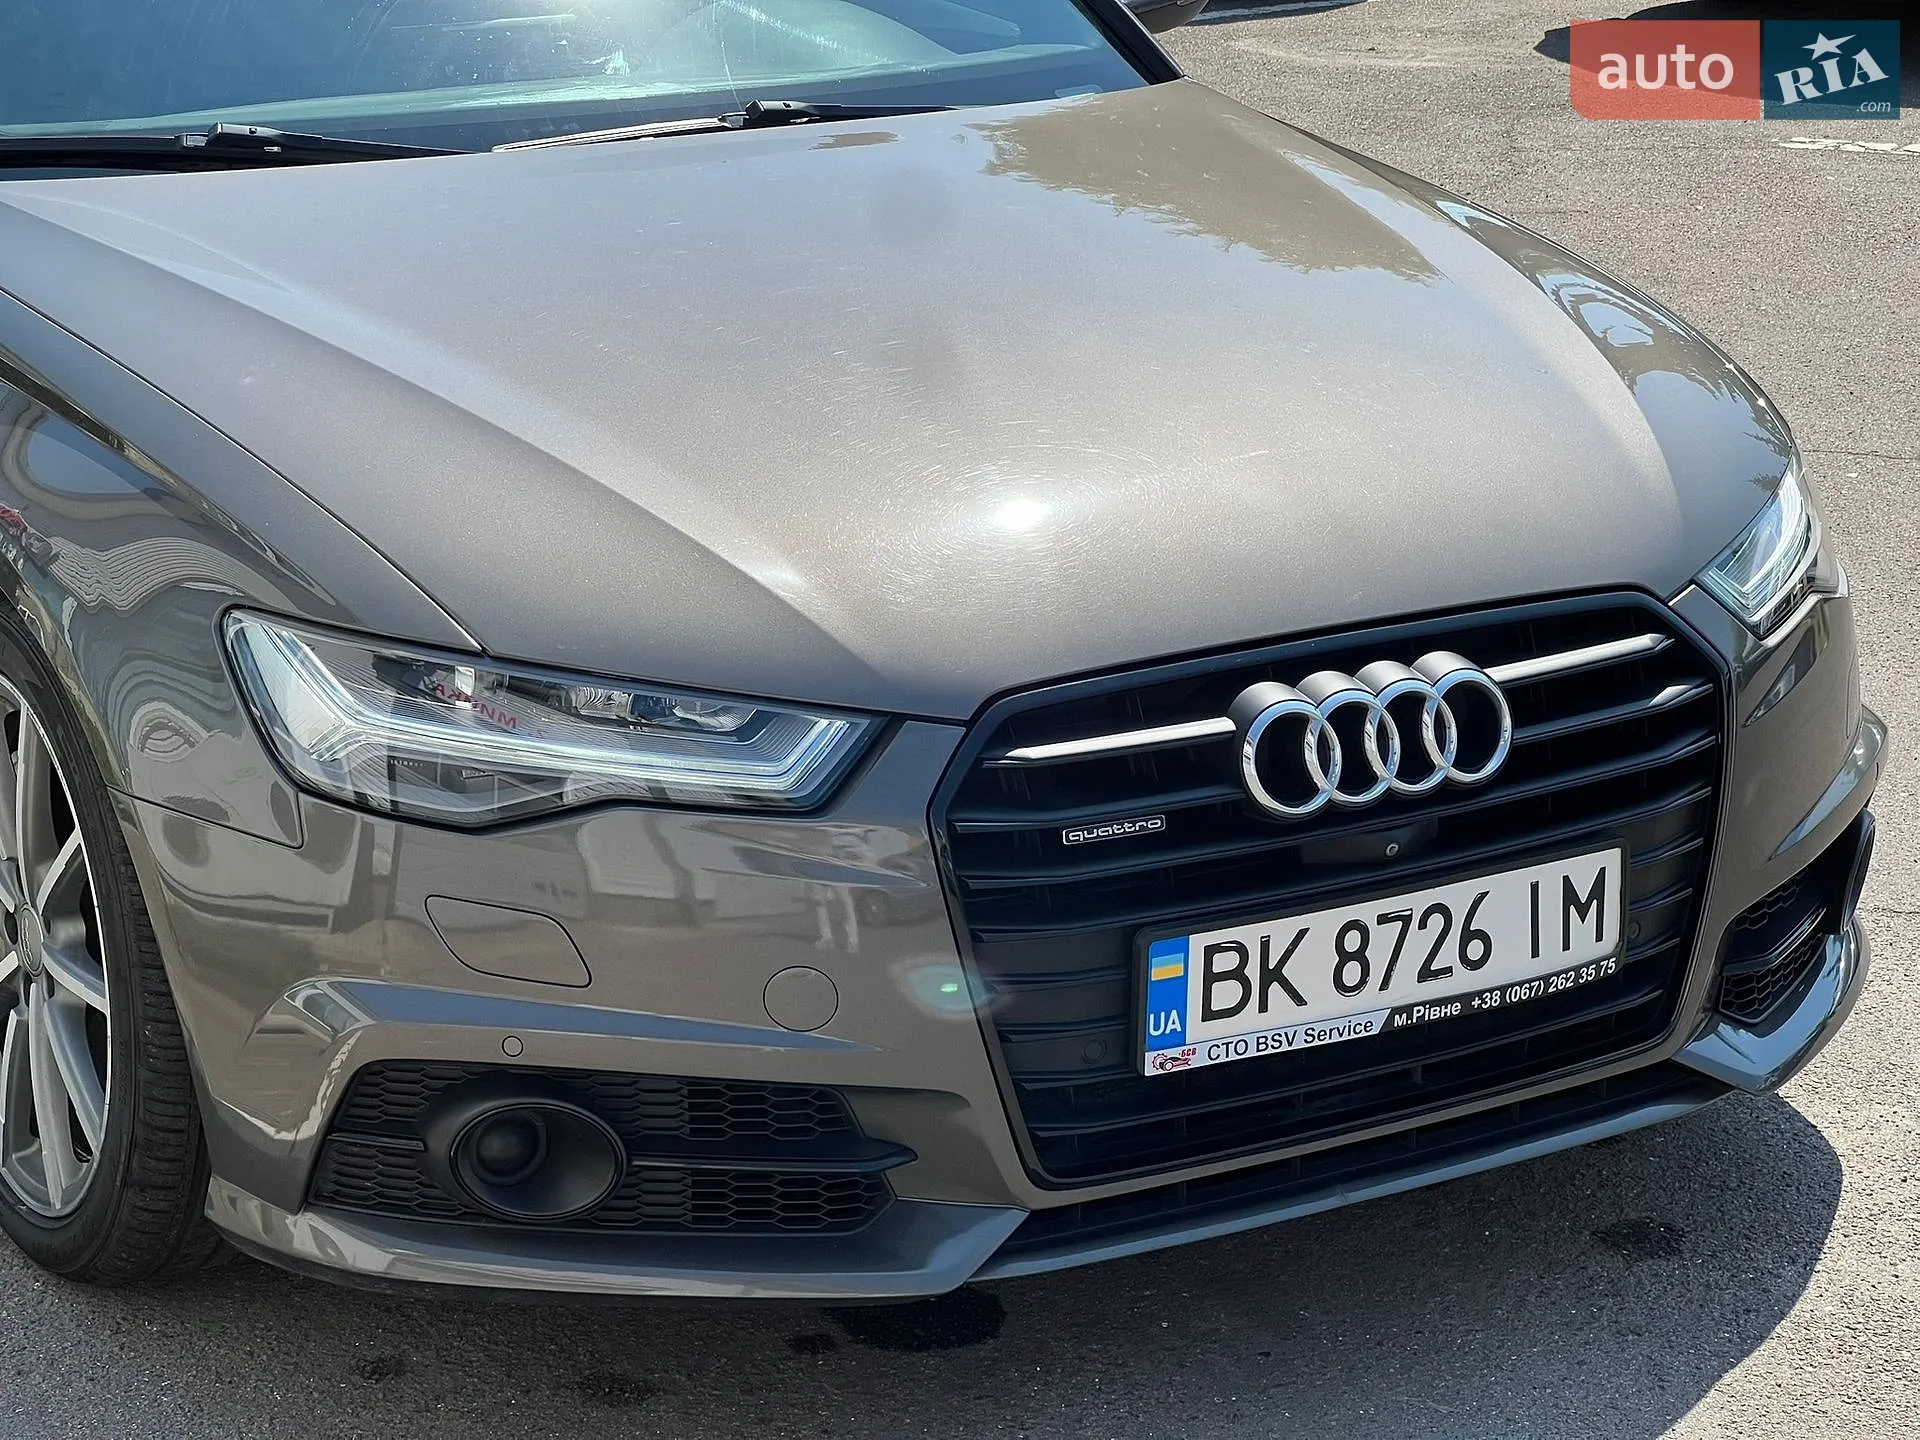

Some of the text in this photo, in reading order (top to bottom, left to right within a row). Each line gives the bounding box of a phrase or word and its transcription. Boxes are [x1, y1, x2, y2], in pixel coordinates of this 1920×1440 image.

[1068, 819, 1161, 841] quattro
[1201, 927, 1309, 1022] BK
[1332, 891, 1493, 997] 8726
[1471, 990, 1501, 1010] +38
[1505, 979, 1544, 1004] (067)
[1548, 971, 1576, 993] 262
[1578, 964, 1596, 984] 35
[1599, 957, 1617, 977] 75
[1149, 1009, 1182, 1036] UA
[1256, 1030, 1297, 1053] BSV
[1303, 1020, 1374, 1044] Service
